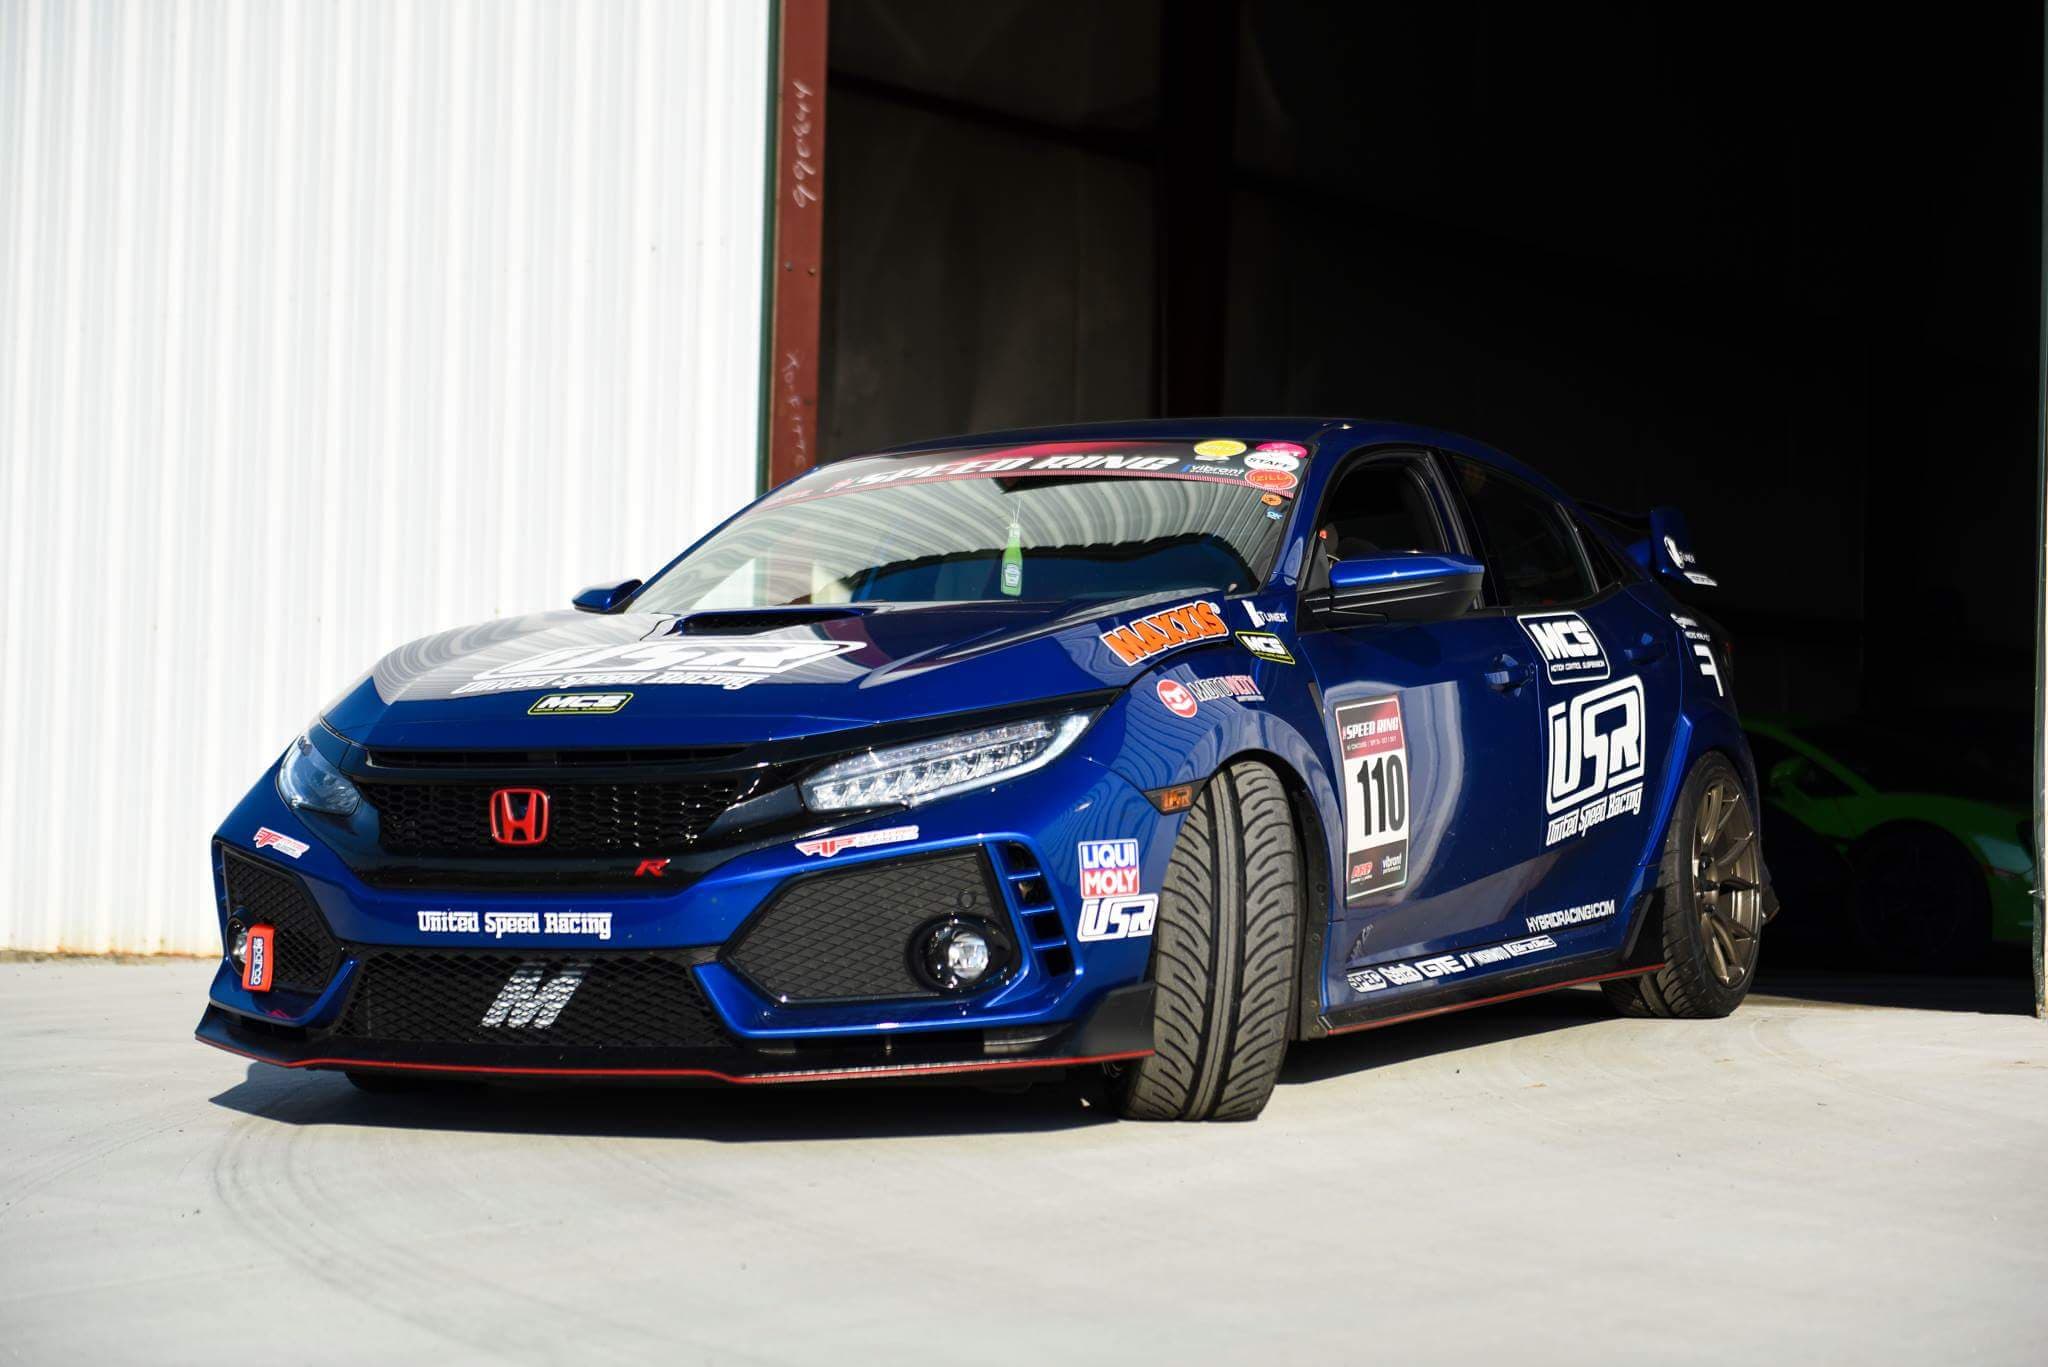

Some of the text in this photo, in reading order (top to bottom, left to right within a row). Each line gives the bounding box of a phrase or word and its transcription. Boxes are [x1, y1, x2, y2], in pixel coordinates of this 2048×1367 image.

[854, 457, 1033, 487] SPEED
[1030, 455, 1181, 472] RING
[1100, 600, 1229, 666] MAXXIS
[1241, 635, 1288, 656] MCS
[1528, 620, 1598, 660] MCS
[537, 695, 628, 710] MCS
[1346, 719, 1376, 740] SPEED
[1356, 754, 1406, 837] 110
[1081, 843, 1137, 869] LIQUI
[1083, 868, 1137, 896] MOLY
[418, 911, 612, 940] United Speed Racing
[1077, 893, 1159, 942] USR
[250, 937, 264, 986] sparco
